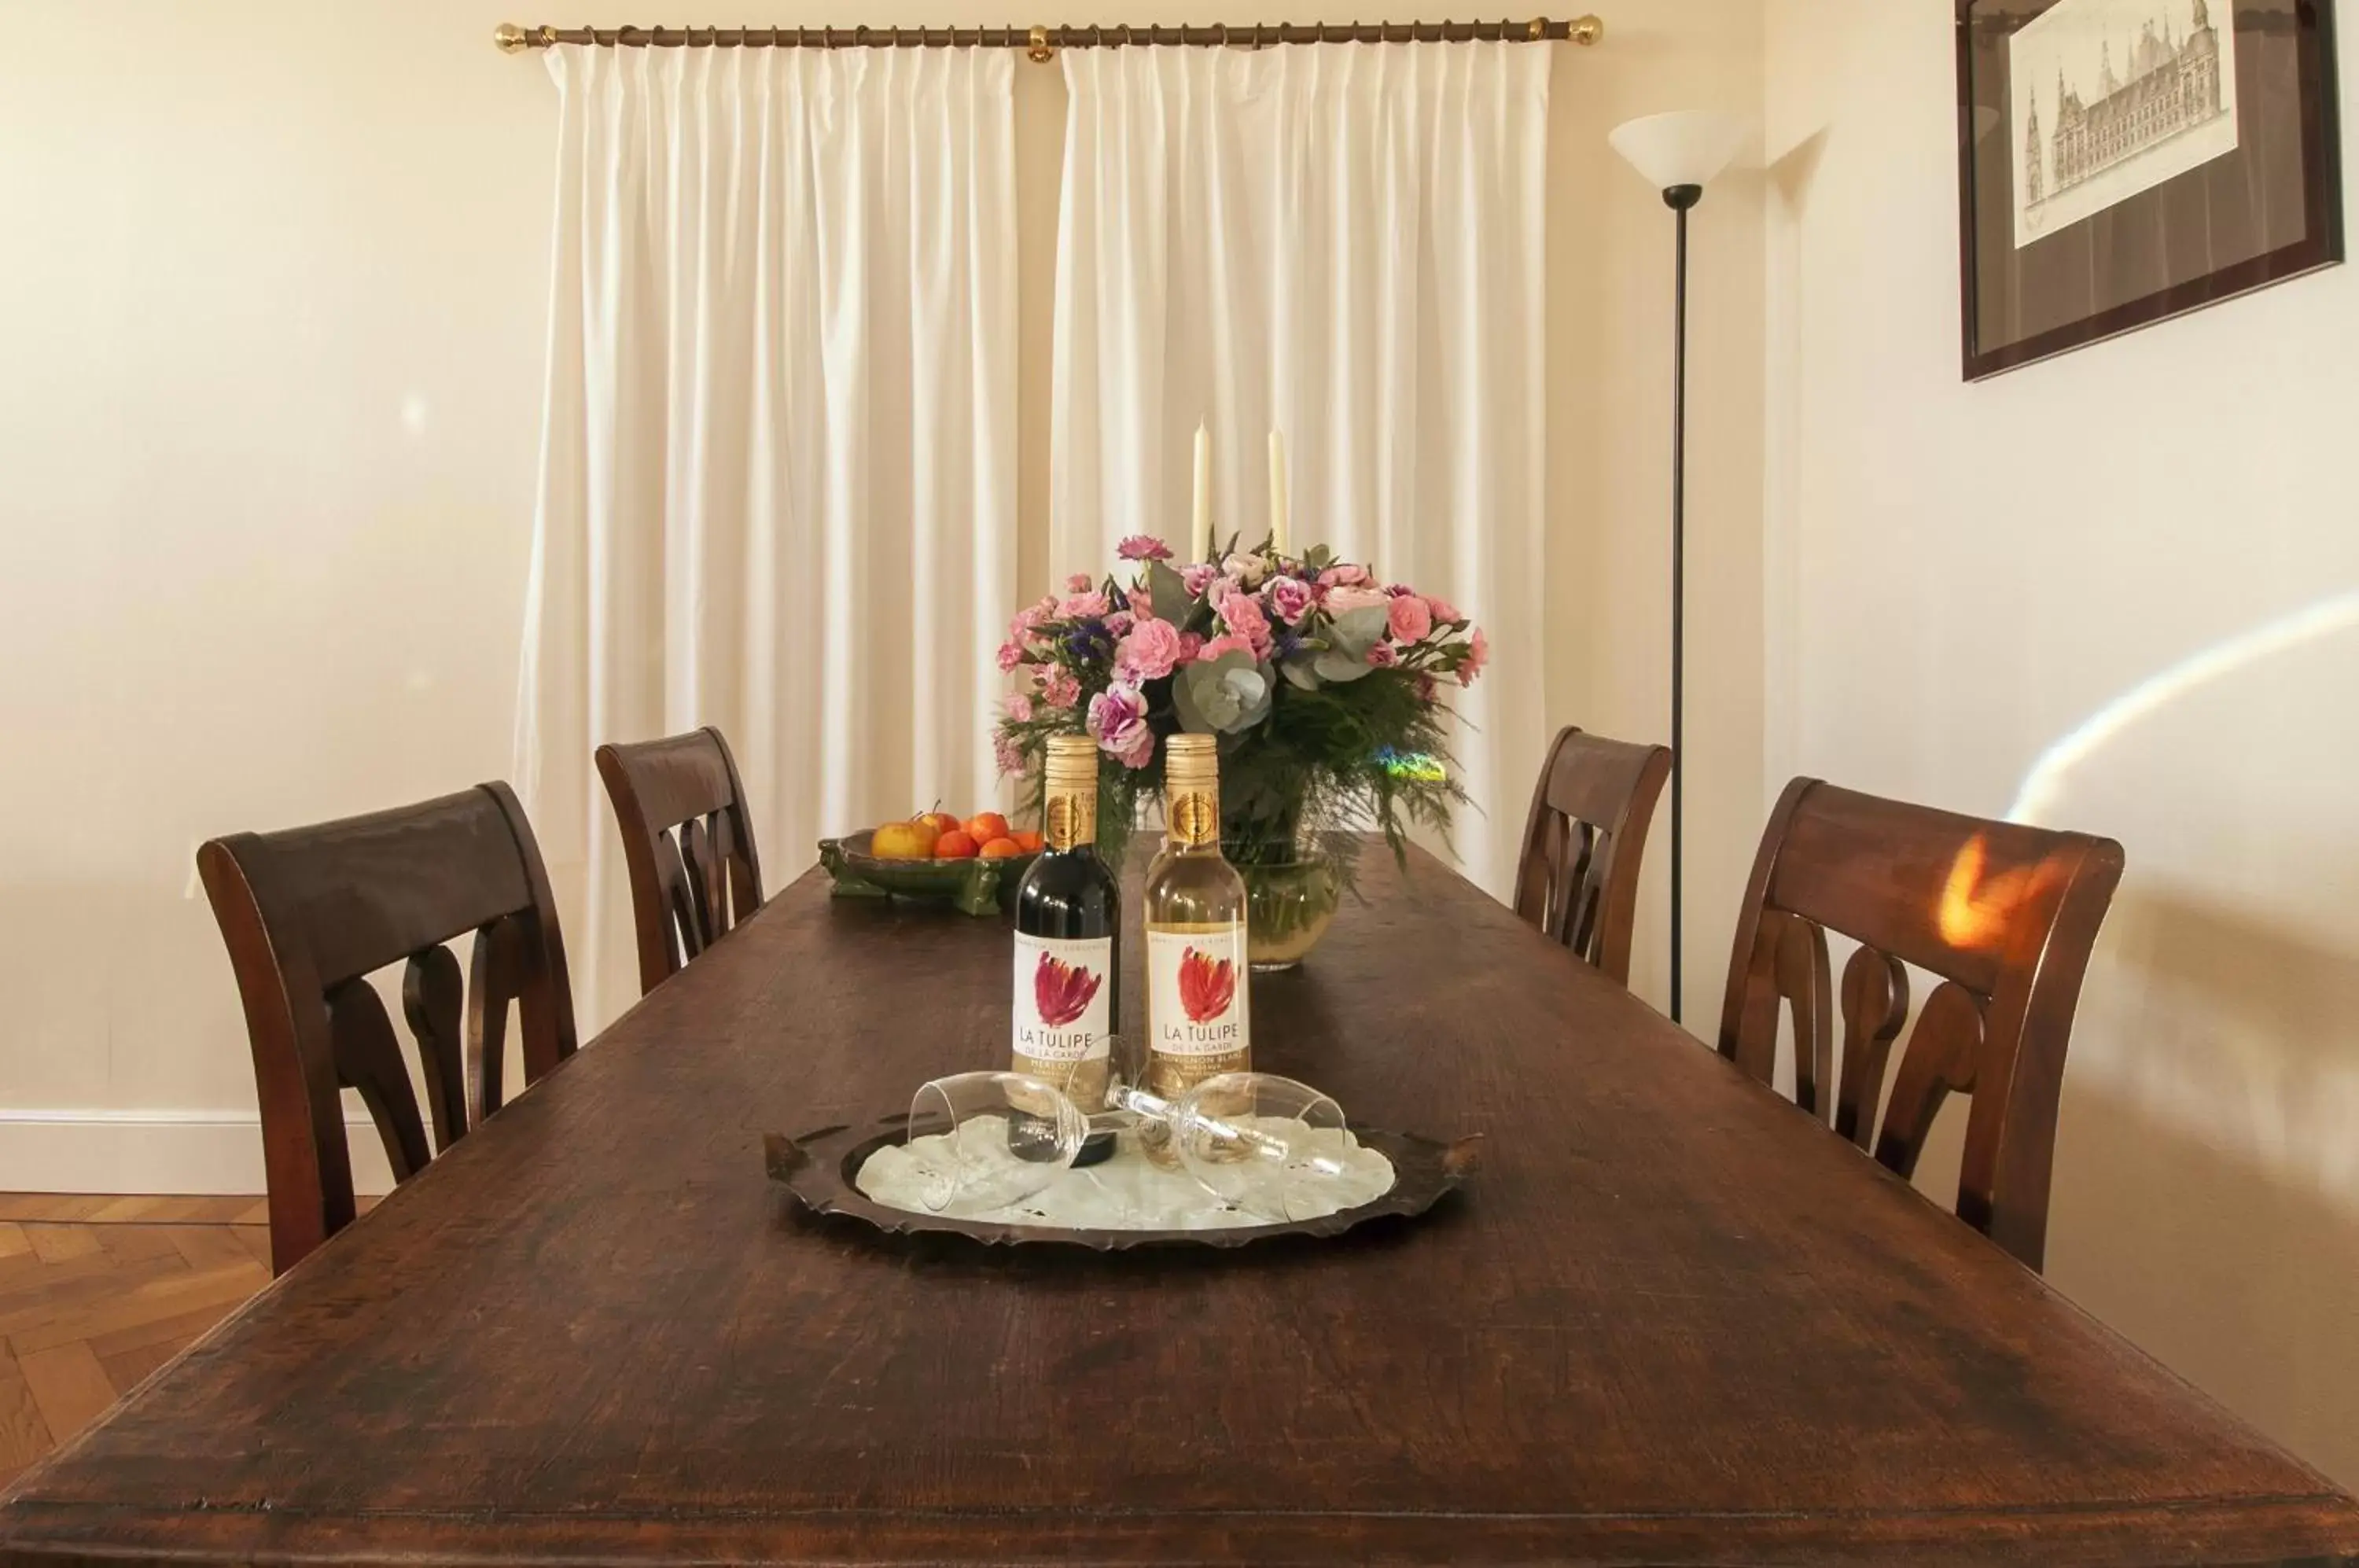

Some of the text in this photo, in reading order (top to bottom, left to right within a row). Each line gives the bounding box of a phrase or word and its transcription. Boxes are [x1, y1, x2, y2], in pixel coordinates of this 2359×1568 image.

[1020, 1026, 1093, 1047] LA TULIPE
[1165, 1023, 1239, 1041] LA TULIPE
[1189, 1043, 1200, 1052] LA
